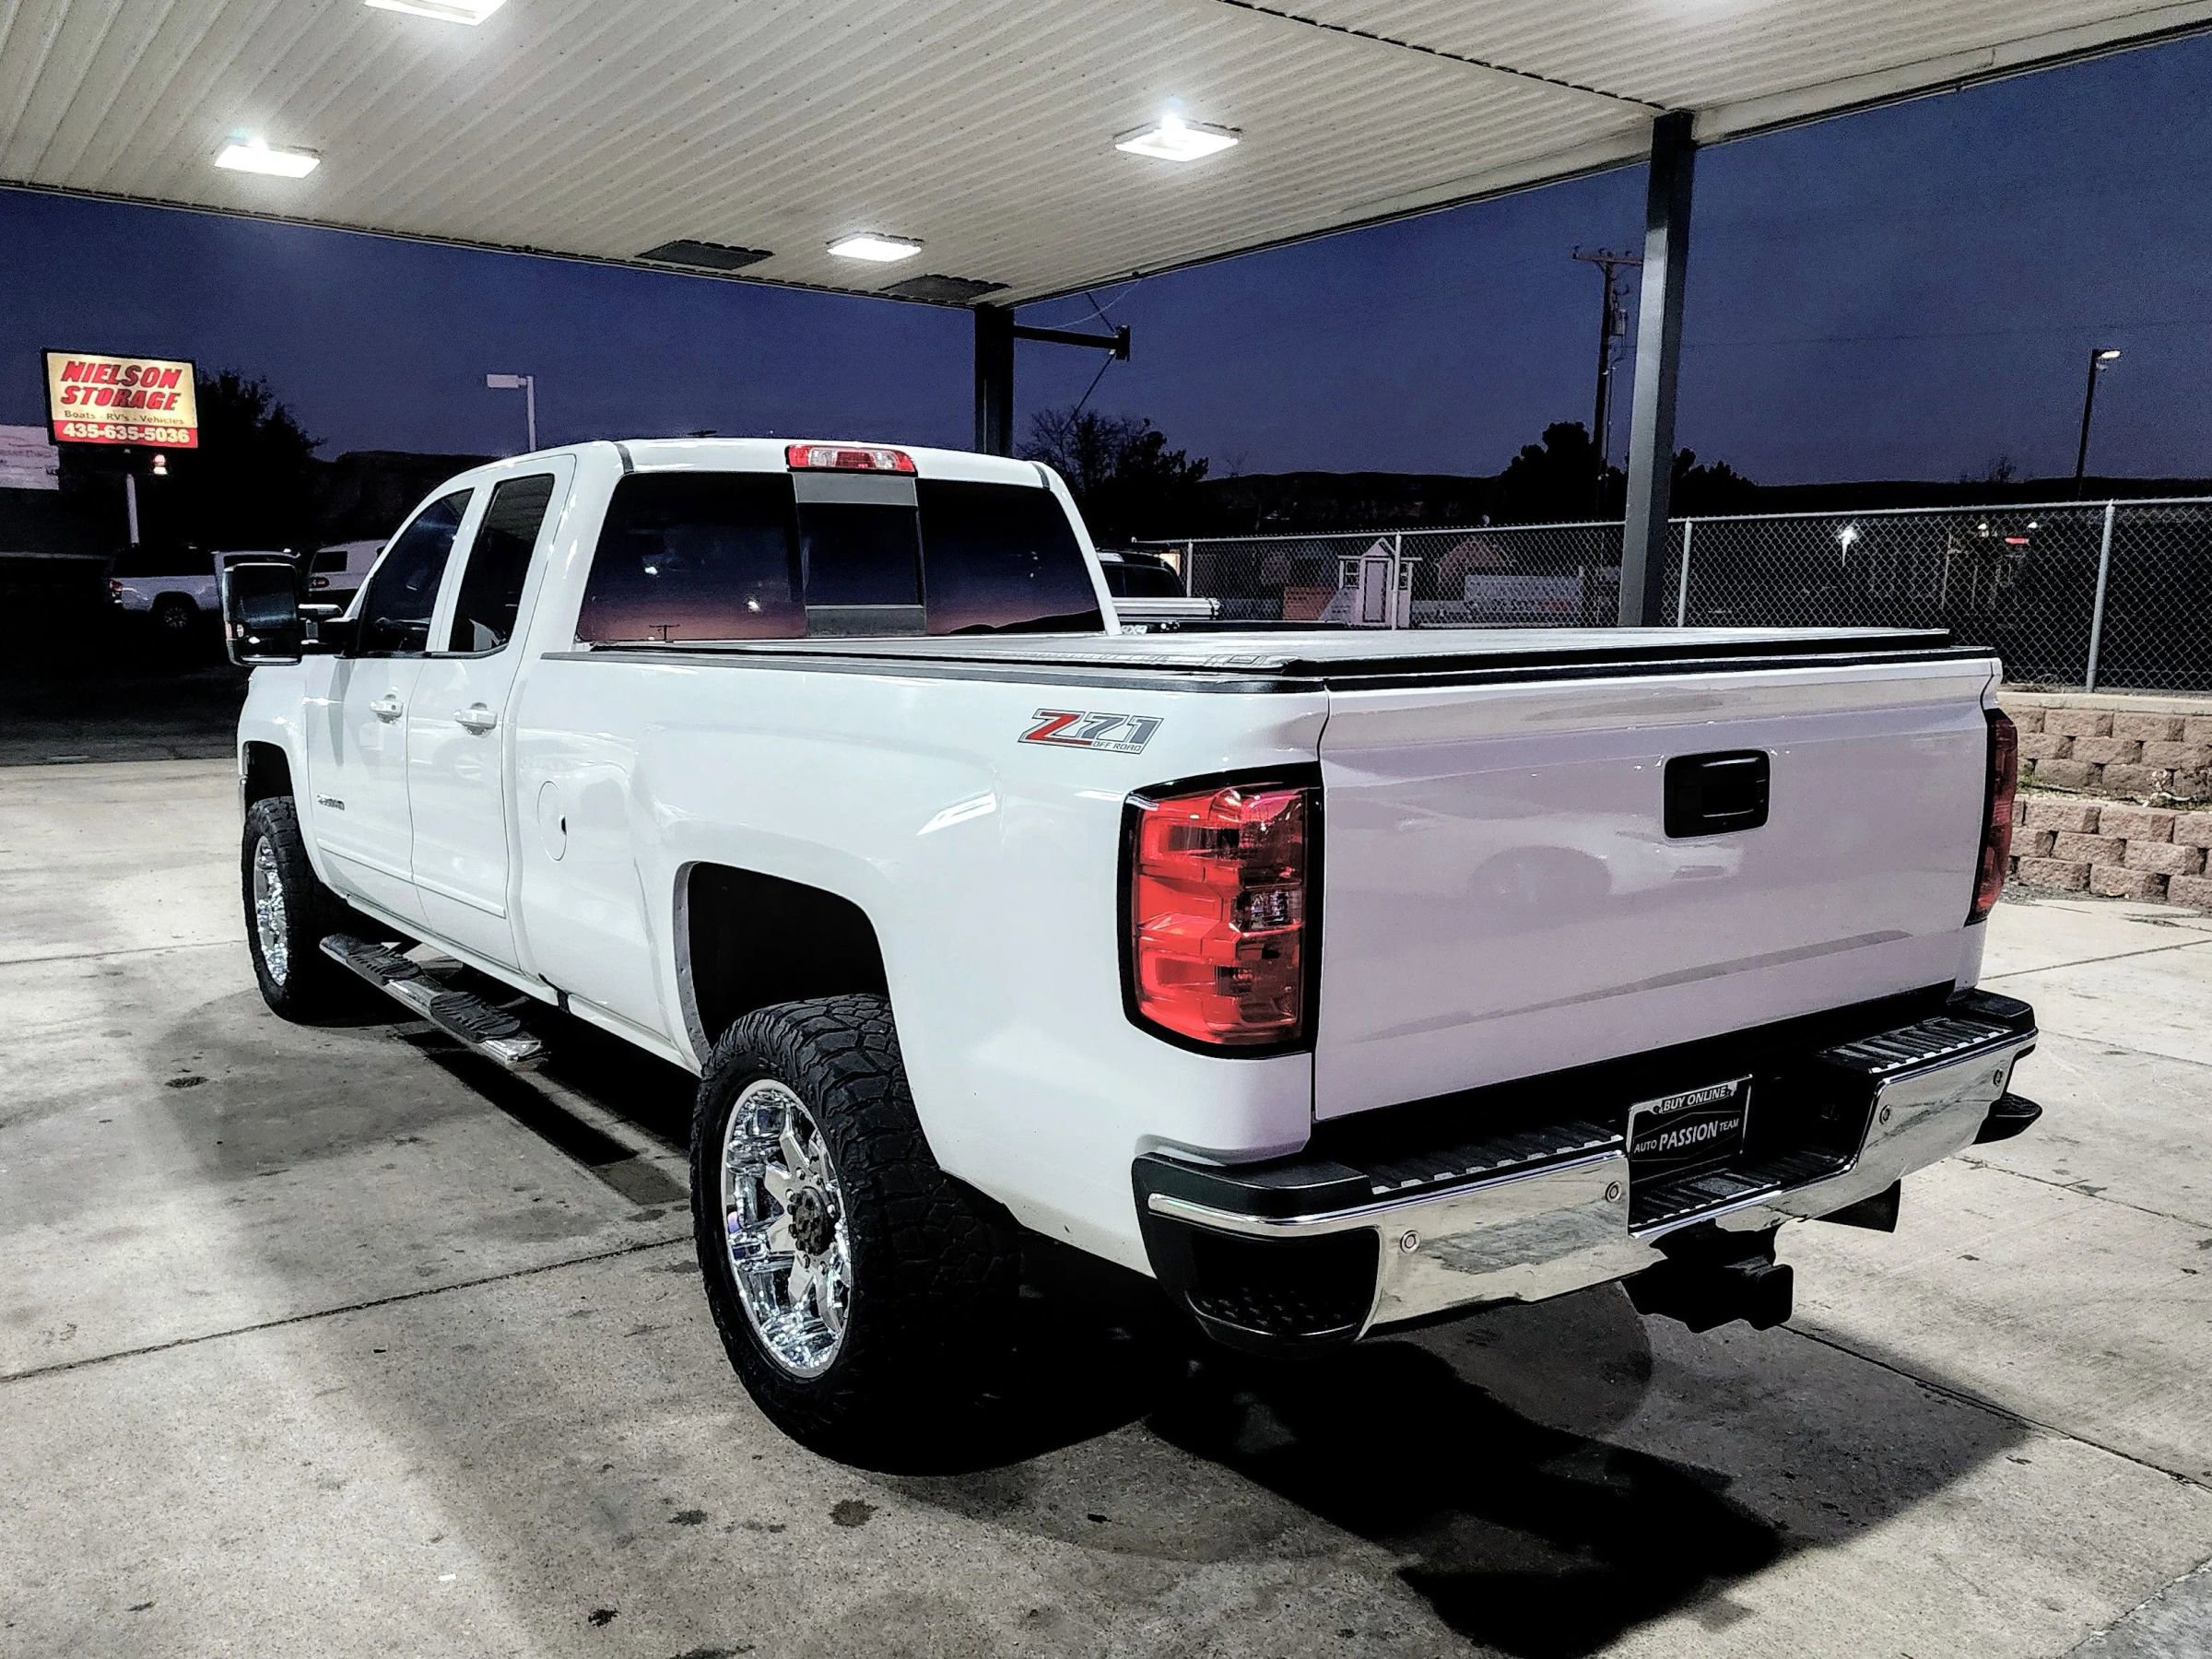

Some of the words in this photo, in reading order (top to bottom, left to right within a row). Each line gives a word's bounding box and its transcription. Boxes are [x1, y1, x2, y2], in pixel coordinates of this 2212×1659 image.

[61, 360, 182, 389] NIELSON
[61, 385, 181, 411] STORAGE
[64, 410, 96, 419] Boats
[139, 415, 184, 425] Vehicles
[63, 422, 191, 443] 435-635-5036
[1018, 708, 1164, 751] Z71
[1092, 740, 1112, 749] OFF
[1112, 743, 1142, 752] ROAD
[1664, 1096, 1686, 1112] BUY
[1687, 1086, 1727, 1106] ONLINE
[1633, 1139, 1657, 1153] AUTO
[1658, 1120, 1719, 1151] PASSION
[1719, 1118, 1739, 1133] TEAM
